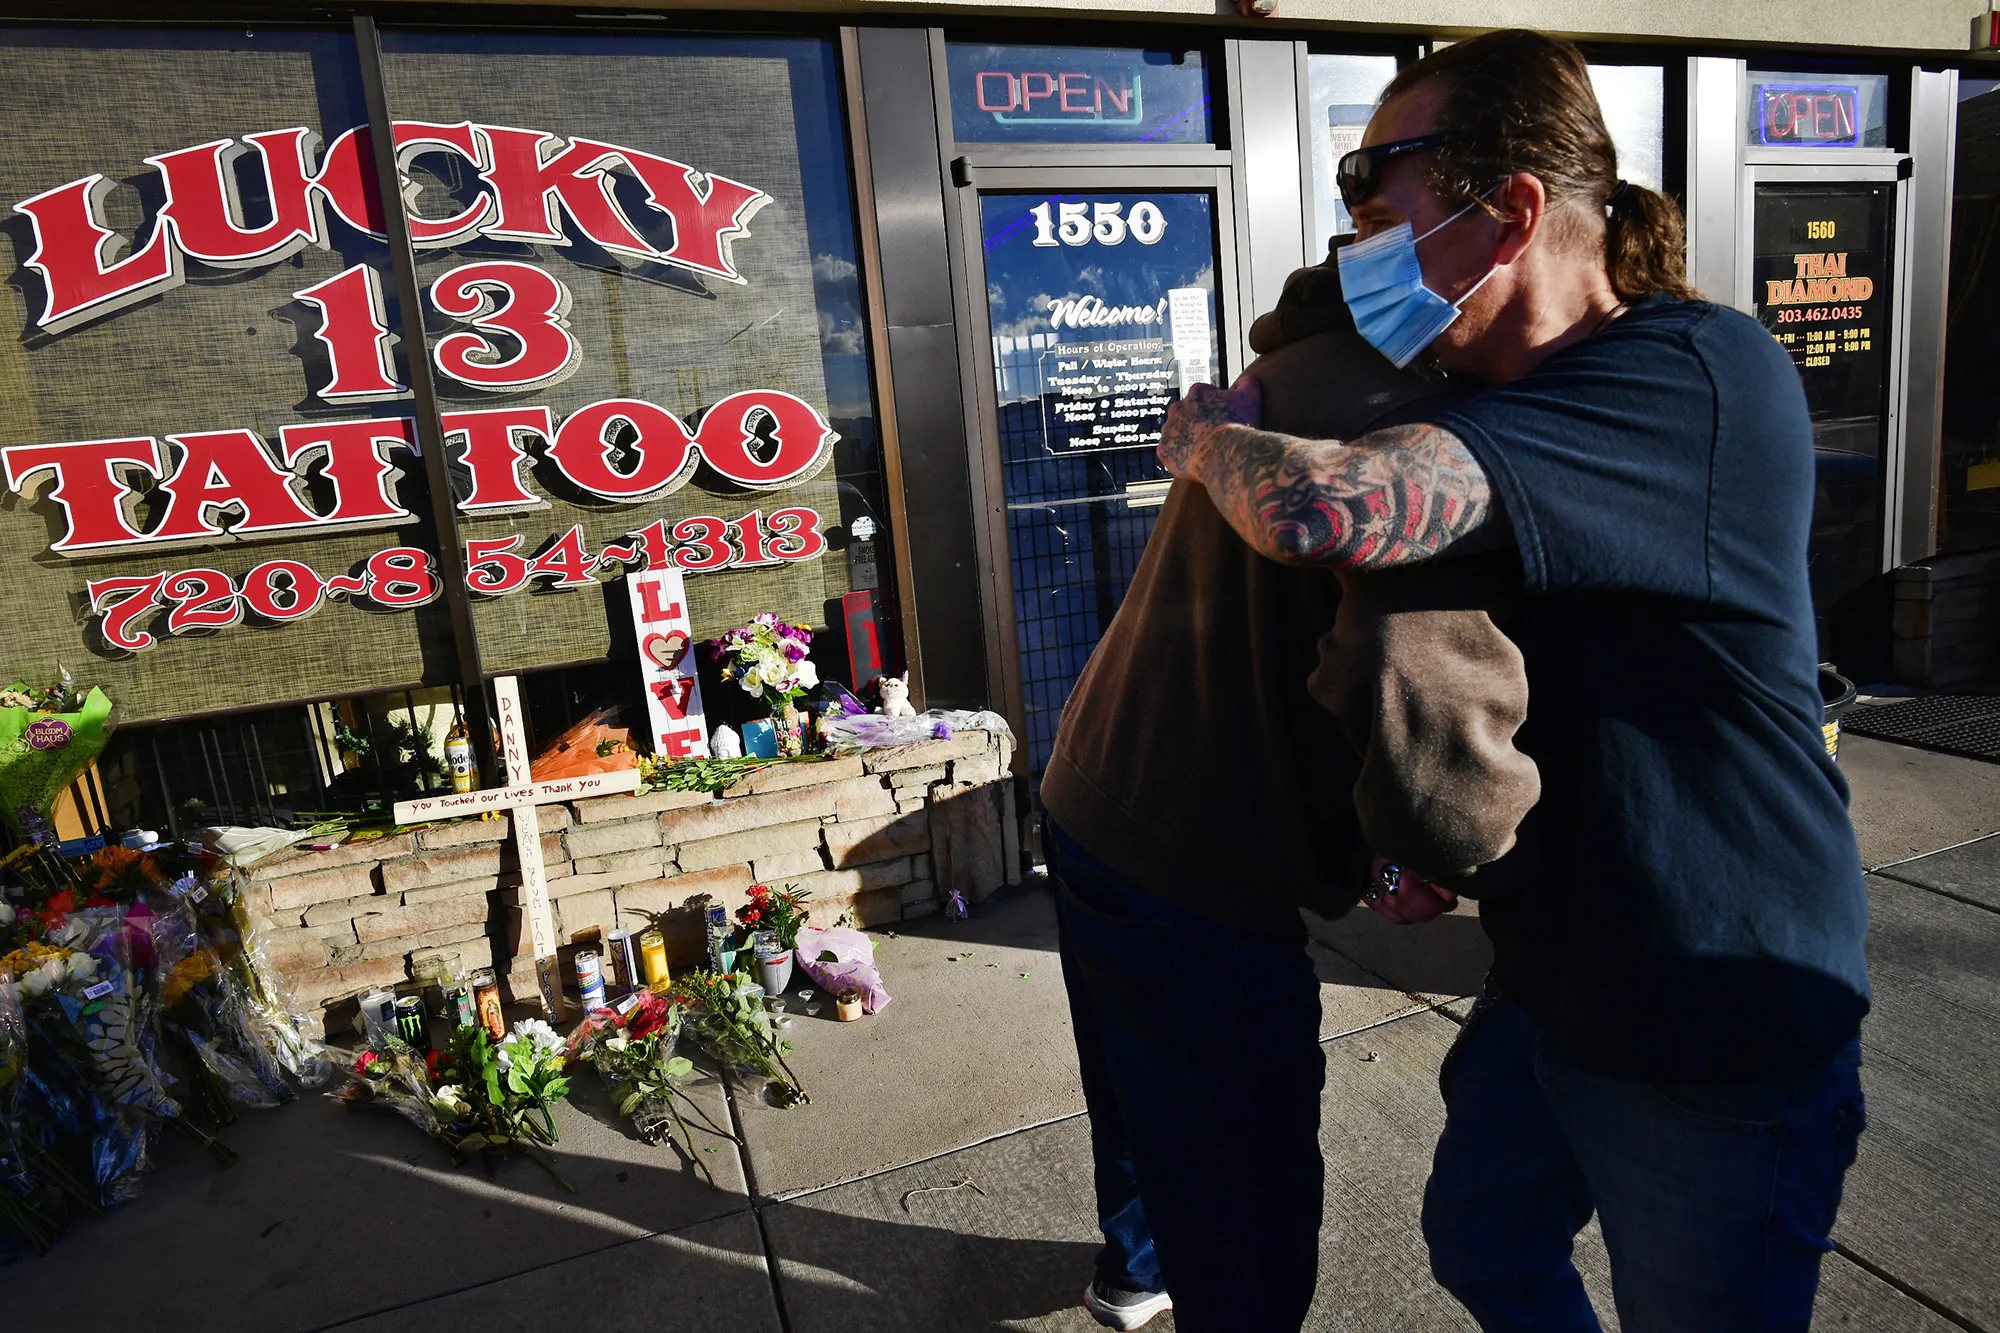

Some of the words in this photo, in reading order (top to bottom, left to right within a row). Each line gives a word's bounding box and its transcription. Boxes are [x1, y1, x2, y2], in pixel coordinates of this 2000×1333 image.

[976, 71, 1128, 113] OPEN
[1767, 91, 1856, 138] OPEN
[1332, 133, 1357, 142] NEVER
[1334, 142, 1355, 150] MIND
[13, 121, 774, 335] LUCKY
[1029, 201, 1168, 247] 1550
[1807, 221, 1836, 239] 1560
[1794, 252, 1848, 279] THAI
[1766, 276, 1874, 306] DIAMOND
[1047, 294, 1169, 330] Welcome!
[1777, 306, 1863, 323] 303.462.0435
[293, 261, 582, 405] 13
[1806, 331, 1823, 342] 11:00
[1824, 330, 1836, 341] AM
[1843, 329, 1858, 340] 9:00
[1860, 328, 1870, 339] PM
[1058, 345, 1089, 355] Hours
[1093, 342, 1104, 352] of
[1107, 340, 1161, 353] Operation:
[1806, 343, 1824, 354] 12:00
[1825, 342, 1836, 353] PM
[1844, 341, 1859, 352] 9:00
[1860, 340, 1871, 351] PM
[1057, 361, 1078, 372] Fall
[1081, 360, 1088, 370] /
[1092, 358, 1128, 369] Winter
[1130, 356, 1163, 366] Hours:
[1805, 355, 1831, 367] CLOSED
[1047, 375, 1101, 387] Tuesday
[1115, 370, 1174, 382] Thursday
[1060, 385, 1093, 396] Noon
[1096, 384, 1110, 393] to
[1054, 401, 1096, 415] Friday
[1100, 399, 1110, 409] &
[1114, 395, 1171, 408] Saturday
[1064, 412, 1096, 423] Noon
[1092, 423, 1139, 435] Sunday
[1069, 436, 1101, 448] Noon
[1, 389, 841, 556] TATTOO
[35, 727, 64, 735] BLOOM
[776, 719, 793, 729] RIP
[776, 726, 802, 739] DANO
[36, 734, 64, 744] HAUS
[501, 697, 520, 781] DANNY
[480, 792, 500, 803] our
[542, 782, 574, 794] Thank
[542, 970, 557, 1024] PROUD
